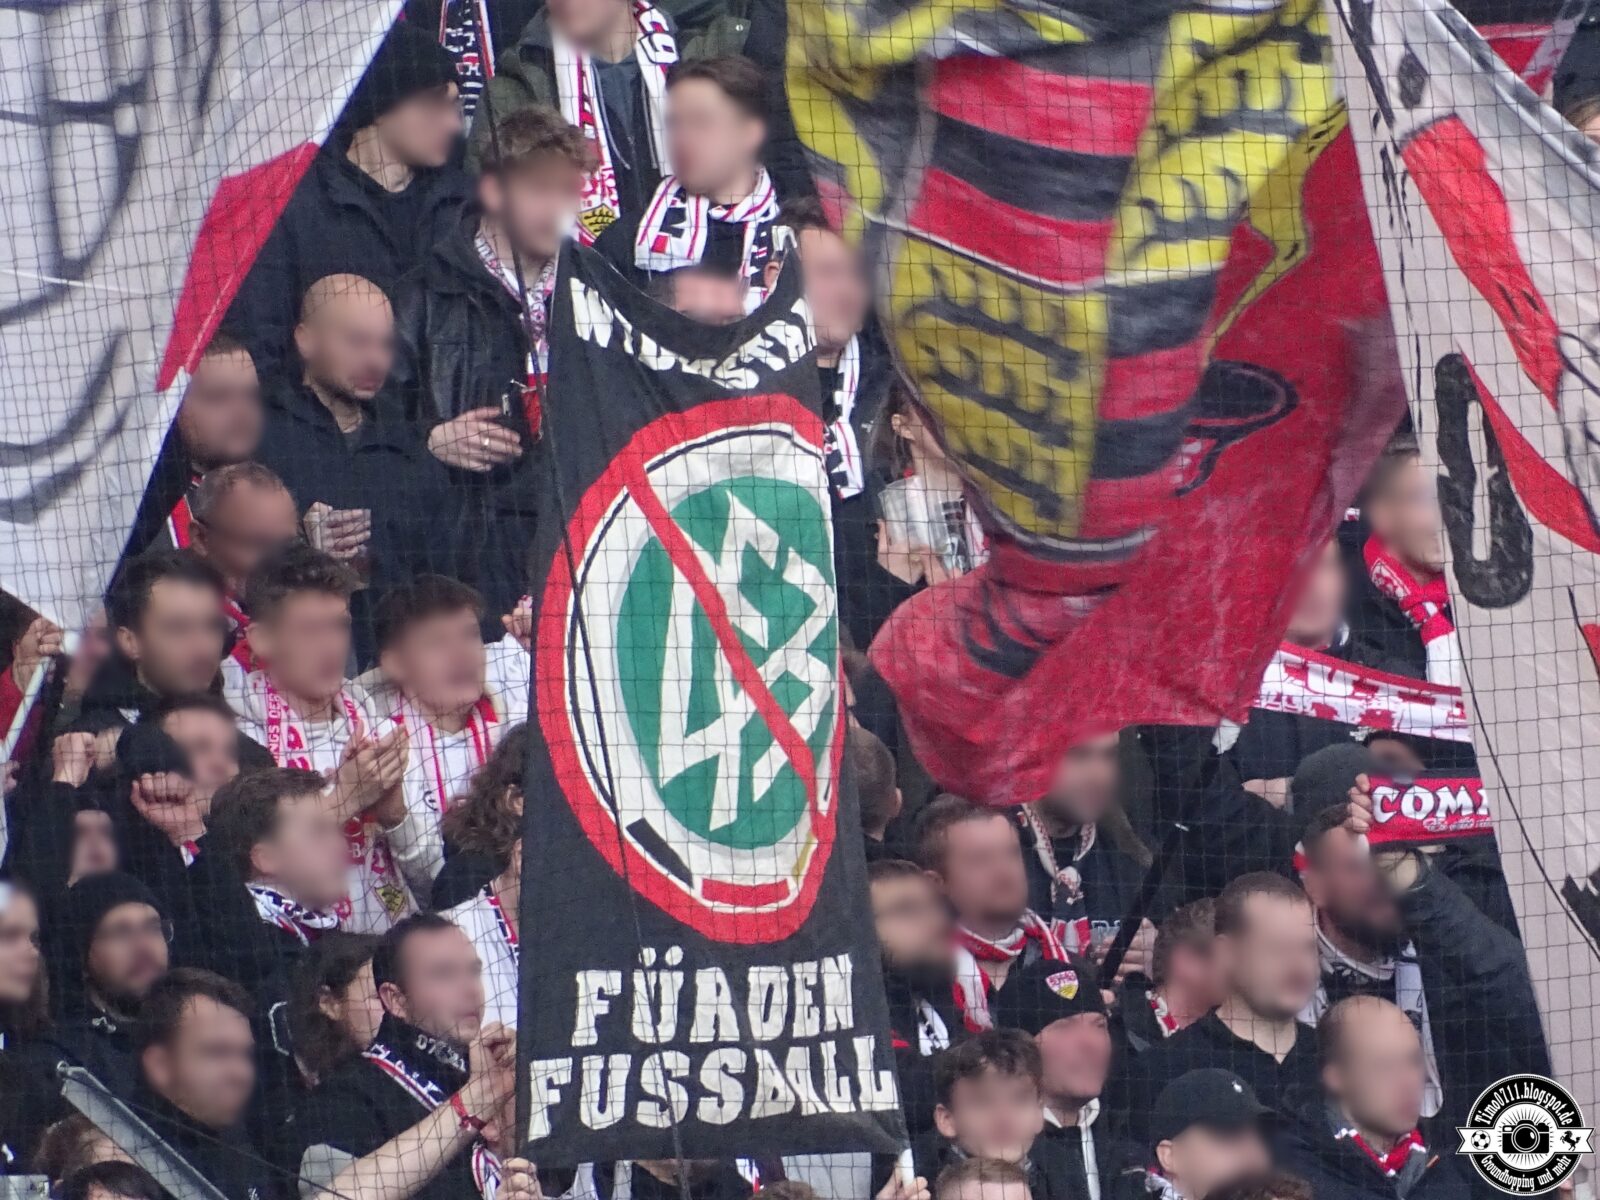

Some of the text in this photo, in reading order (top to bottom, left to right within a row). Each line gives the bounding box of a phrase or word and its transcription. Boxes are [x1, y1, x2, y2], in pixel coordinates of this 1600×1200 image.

[571, 945, 740, 1047] FÜR
[748, 953, 854, 1042] DEN
[528, 1035, 899, 1142] FUSSBALL
